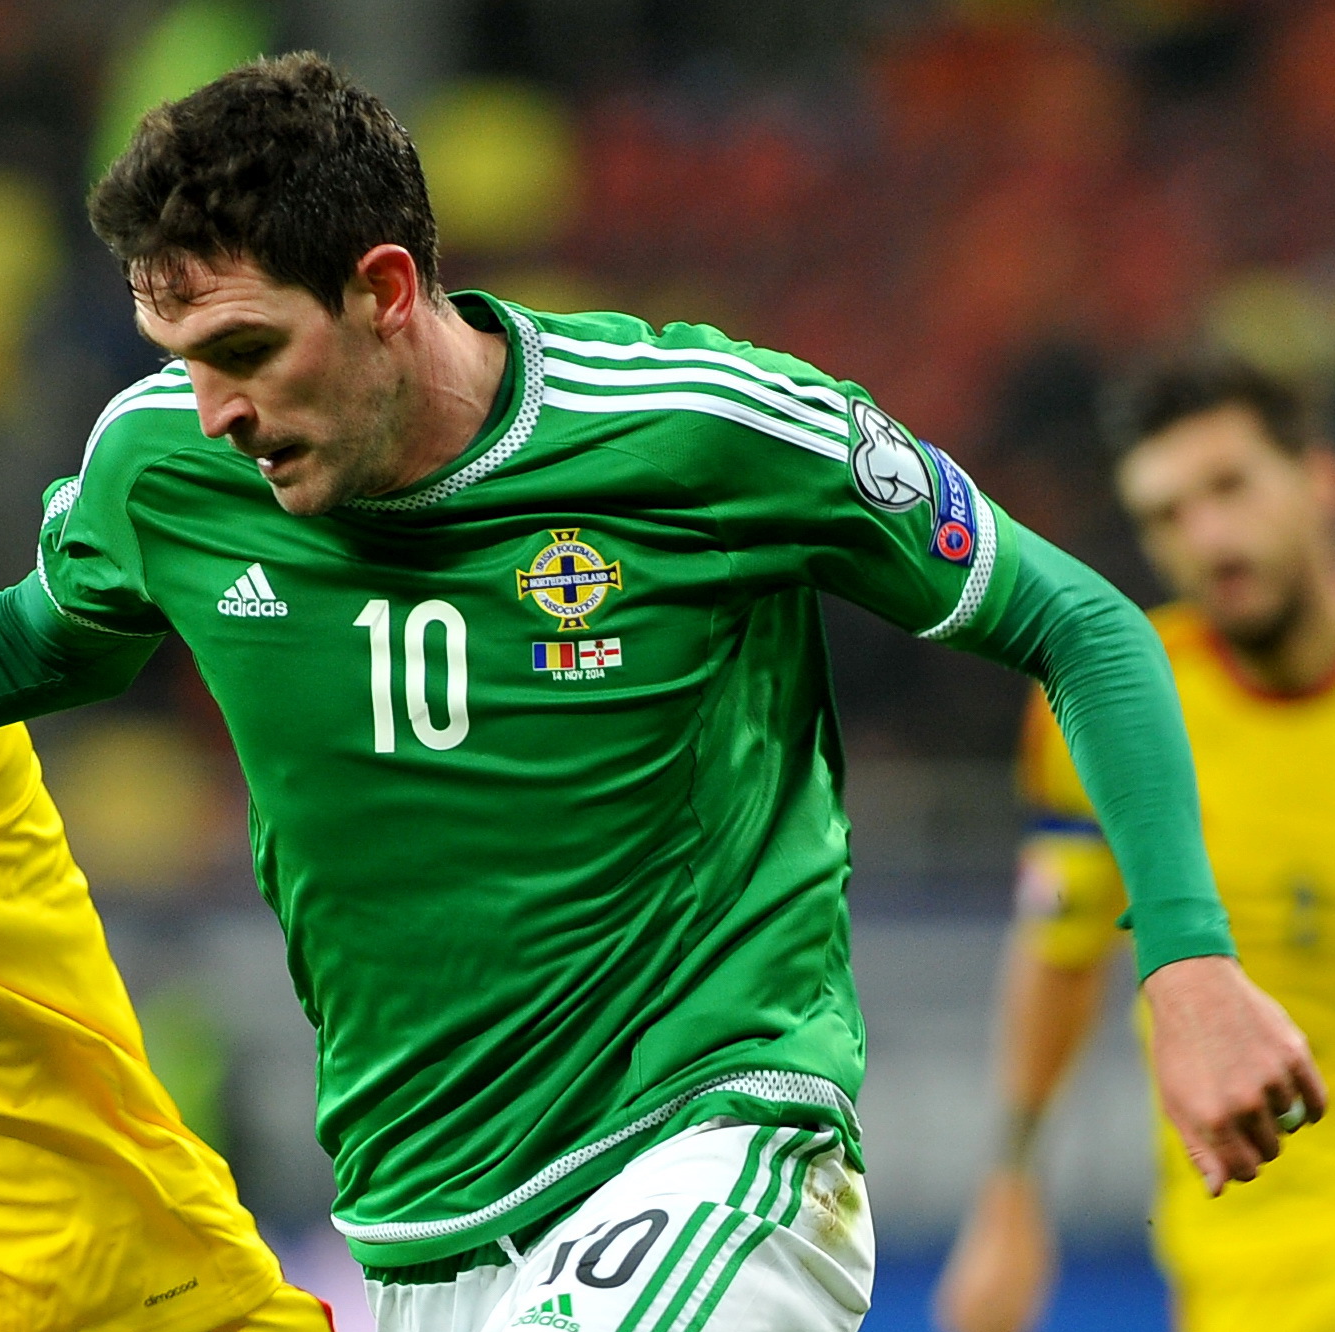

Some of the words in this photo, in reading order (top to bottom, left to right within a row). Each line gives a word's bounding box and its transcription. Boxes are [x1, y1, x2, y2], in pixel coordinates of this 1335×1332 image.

[536, 548, 555, 570] IRISH
[529, 575, 572, 588] NORTHERN
[573, 572, 608, 585] IRELAND
[217, 598, 288, 617] adidas
[541, 593, 599, 615] ASSOCIATION
[352, 599, 470, 753] 10
[552, 670, 562, 681] 14
[564, 670, 584, 681] NOV
[585, 668, 605, 680] 2014
